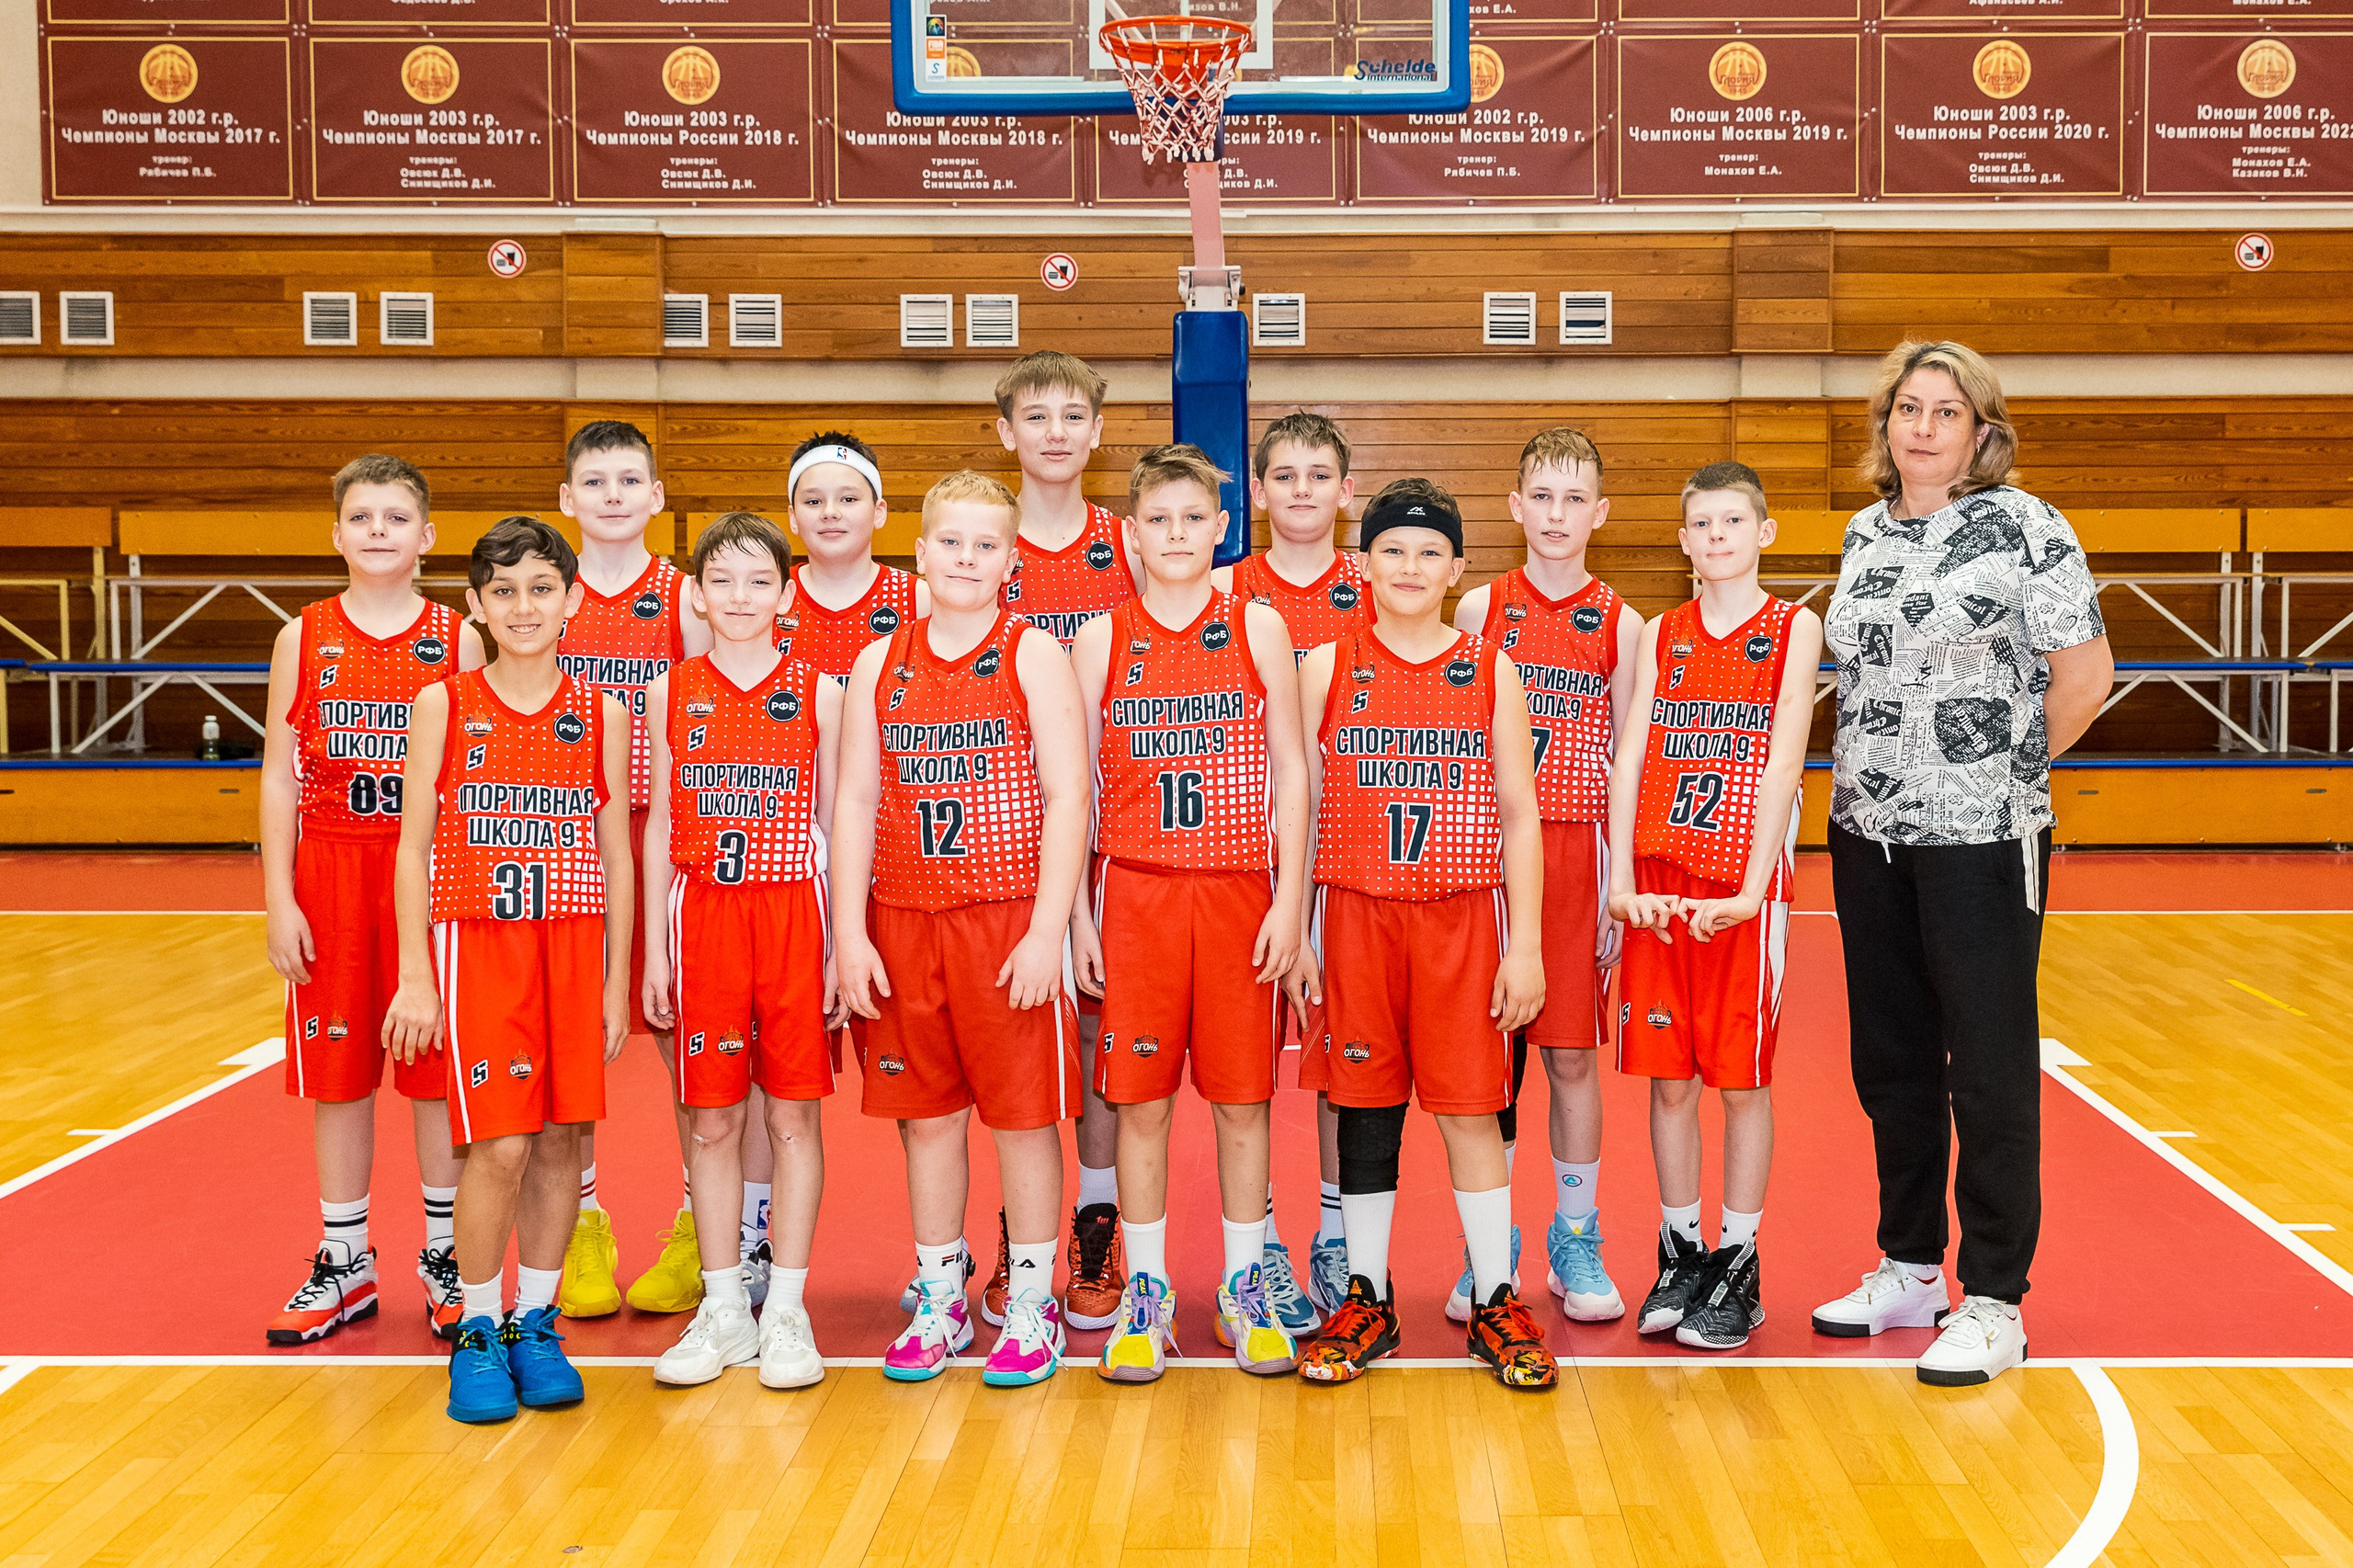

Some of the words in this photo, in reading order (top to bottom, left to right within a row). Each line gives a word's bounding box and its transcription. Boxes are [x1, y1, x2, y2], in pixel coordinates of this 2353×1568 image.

[1354, 59, 1436, 80] Schelde
[103, 109, 162, 124] Юноши
[168, 109, 205, 124] 2002
[211, 112, 238, 128] г.р.
[364, 110, 423, 125] Юноши
[429, 110, 466, 126] 2003
[473, 114, 502, 129] г.р.
[625, 111, 683, 126] Юноши
[690, 111, 727, 126] 2003
[733, 114, 761, 130] г.р.
[887, 111, 945, 126] Юноши
[995, 117, 1021, 130] г.р.
[1409, 115, 1467, 124] Юноши
[1473, 109, 1510, 124] 2002
[1518, 112, 1544, 127] г.р.
[1670, 108, 1729, 122] Юноши
[1736, 107, 1773, 122] 2006
[1779, 109, 1806, 125] г.р.
[1934, 106, 1993, 120] Юноши
[2000, 106, 2037, 120] 2003
[2044, 108, 2071, 123] г.р.
[2198, 105, 2256, 119] Юноши
[2264, 105, 2302, 119] 2006
[2308, 107, 2335, 122] г.р.
[62, 128, 148, 142] Чемпионы
[154, 128, 219, 143] Москвы
[224, 129, 263, 143] 2017
[269, 129, 279, 142] г.
[323, 129, 409, 144] Чемпионы
[415, 129, 480, 144] Москвы
[485, 130, 523, 144] 2017
[530, 130, 540, 144] г.
[586, 130, 672, 145] Чемпионы
[679, 130, 738, 145] России
[745, 130, 781, 145] 2018
[789, 130, 799, 144] г.
[846, 131, 931, 145] Чемпионы
[938, 131, 1002, 145] Москвы
[1007, 131, 1045, 145] 2018
[1052, 131, 1063, 145] г.
[1267, 130, 1303, 144] 2019
[1311, 130, 1321, 143] г.
[1368, 129, 1453, 143] Чемпионы
[1461, 128, 1524, 143] Москвы
[1529, 128, 1568, 142] 2019
[1574, 128, 1585, 143] г.
[1629, 126, 1715, 142] Чемпионы
[1722, 126, 1786, 141] Москвы
[1791, 126, 1830, 142] 2019
[1836, 126, 1847, 142] г.
[1895, 125, 1982, 140] Чемпионы
[1988, 124, 2048, 139] России
[2054, 124, 2091, 139] 2020
[2098, 124, 2109, 139] г.
[2155, 124, 2243, 139] Чемпионы
[2249, 123, 2314, 138] Москвы
[931, 158, 978, 166] тренеры:
[1969, 164, 2006, 173] Овсюк
[2010, 164, 2034, 174] Д.В.
[2233, 158, 2283, 167] Монахов
[2285, 158, 2311, 167] Е.А.
[661, 169, 699, 179] Овсюк
[702, 169, 726, 179] Д.В.
[923, 169, 960, 179] Овсюк
[963, 169, 987, 179] Д.В.
[1224, 168, 1247, 179] Д.В.
[1445, 167, 1493, 176] Рябичев
[1497, 167, 1520, 176] П.Б.
[1705, 166, 1755, 176] Монахов
[1759, 165, 1782, 175] Е.А.
[2233, 168, 2279, 177] Казаков
[662, 180, 728, 189] Снимщиков
[732, 179, 756, 189] Д.И.
[923, 180, 989, 189] Снимщиков
[993, 179, 1017, 190] Д.И.
[1254, 179, 1278, 189] Д.И.
[1970, 174, 2037, 184] Снимщиков
[2040, 174, 2064, 184] Д.И.
[1090, 551, 1111, 560] РФБ
[1335, 593, 1354, 601] РФБ
[636, 601, 658, 610] РФБ
[873, 616, 895, 625] РФБ
[1576, 614, 1599, 624] РФБ
[1205, 631, 1227, 641] РФБ
[417, 645, 442, 655] РФБ
[1750, 643, 1769, 653] РФБ
[557, 654, 669, 687] ОРТИВНАЯ
[1450, 669, 1472, 678] РФБ
[1515, 663, 1604, 698] ОРТИВНАЯ
[632, 688, 646, 717] 9
[686, 704, 713, 713] ОГОНЬ
[771, 701, 796, 711] РФБ
[1112, 691, 1244, 726] СПОРТИВНАЯ
[1526, 690, 1568, 720] КОЛА
[1570, 699, 1581, 721] 9
[319, 700, 414, 730] СПОРТИВ
[1650, 698, 1771, 732] СПОРТИВНАЯ
[464, 722, 493, 733] ОГОНЬ
[559, 722, 581, 733] РФБ
[882, 717, 1008, 752] СПОРТИВНАЯ
[328, 733, 407, 760] ШКОЛА
[1131, 728, 1209, 759] ШКОЛА
[1211, 725, 1226, 754] 9
[1336, 726, 1487, 759] СПОРТИВНАЯ
[1663, 732, 1733, 760] ШКОЛА
[1735, 734, 1750, 762] 9
[1531, 726, 1552, 777] 7
[897, 756, 971, 785] ШКОЛА
[972, 752, 989, 781] 9
[1357, 759, 1444, 790] ШКОЛА
[1448, 761, 1461, 790] 9
[681, 764, 800, 790] СПОРТИВНАЯ
[349, 772, 403, 815] 89
[1156, 770, 1205, 832] 16
[1668, 770, 1725, 833] 52
[698, 792, 762, 818] ШКОЛА
[765, 794, 779, 819] 9
[469, 817, 555, 847] ШКОЛА
[560, 821, 575, 849] 9
[915, 798, 969, 858] 12
[1384, 801, 1434, 864] 17
[715, 829, 748, 884] 3
[493, 860, 546, 921] 31
[1647, 1015, 1672, 1024] ОГОНЬ
[718, 1040, 745, 1051] ОГОНЬ
[1132, 1042, 1158, 1053] ОГОНЬ
[1343, 1048, 1370, 1059] ОГОНЬ
[879, 1061, 904, 1071] ОГОНЬ
[1139, 1278, 1147, 1294] PEAK
